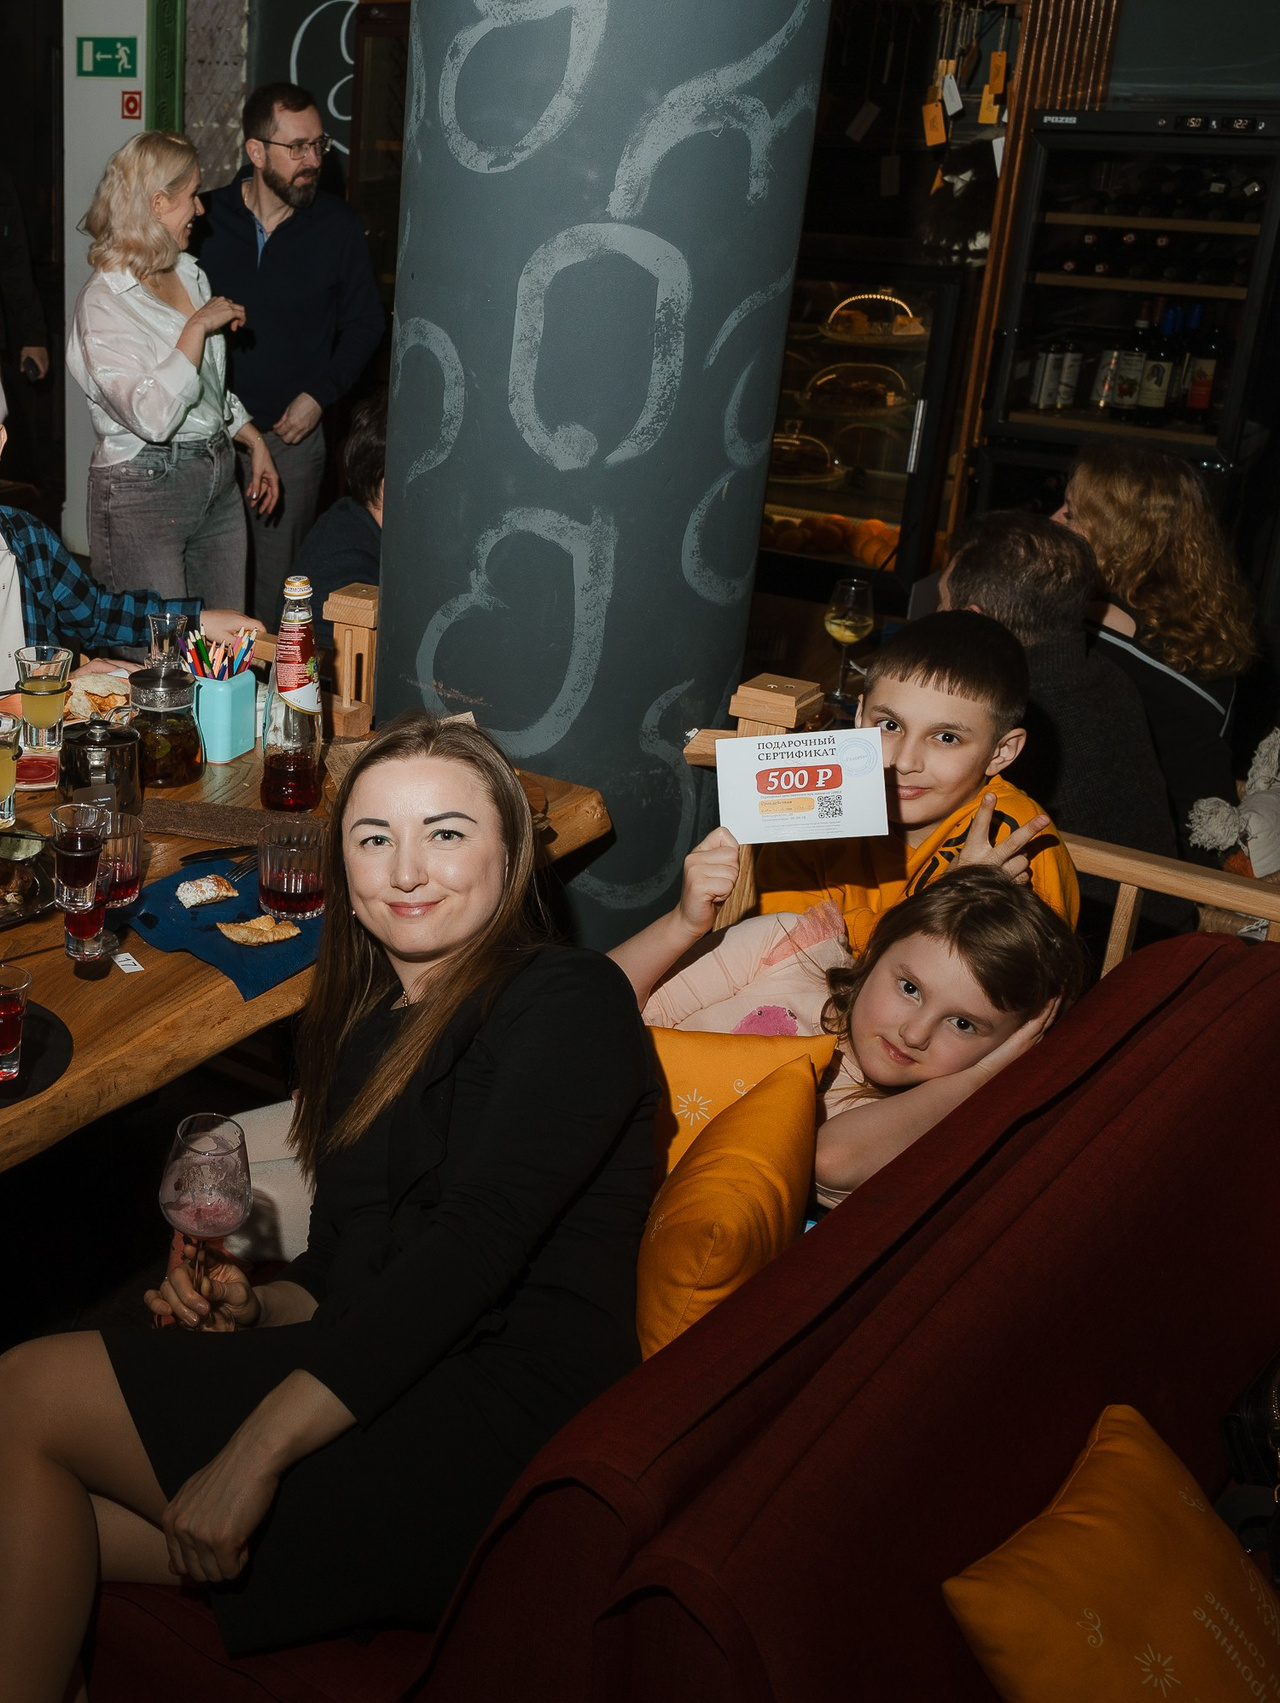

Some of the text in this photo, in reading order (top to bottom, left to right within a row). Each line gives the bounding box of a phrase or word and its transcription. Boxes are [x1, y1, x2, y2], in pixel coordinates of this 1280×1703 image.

[757, 735, 836, 750] ПОДАРОЧНЫЙ
[757, 748, 837, 761] СЕРТИФИКАТ
[766, 769, 809, 791] 500
[117, 957, 138, 967] 17
